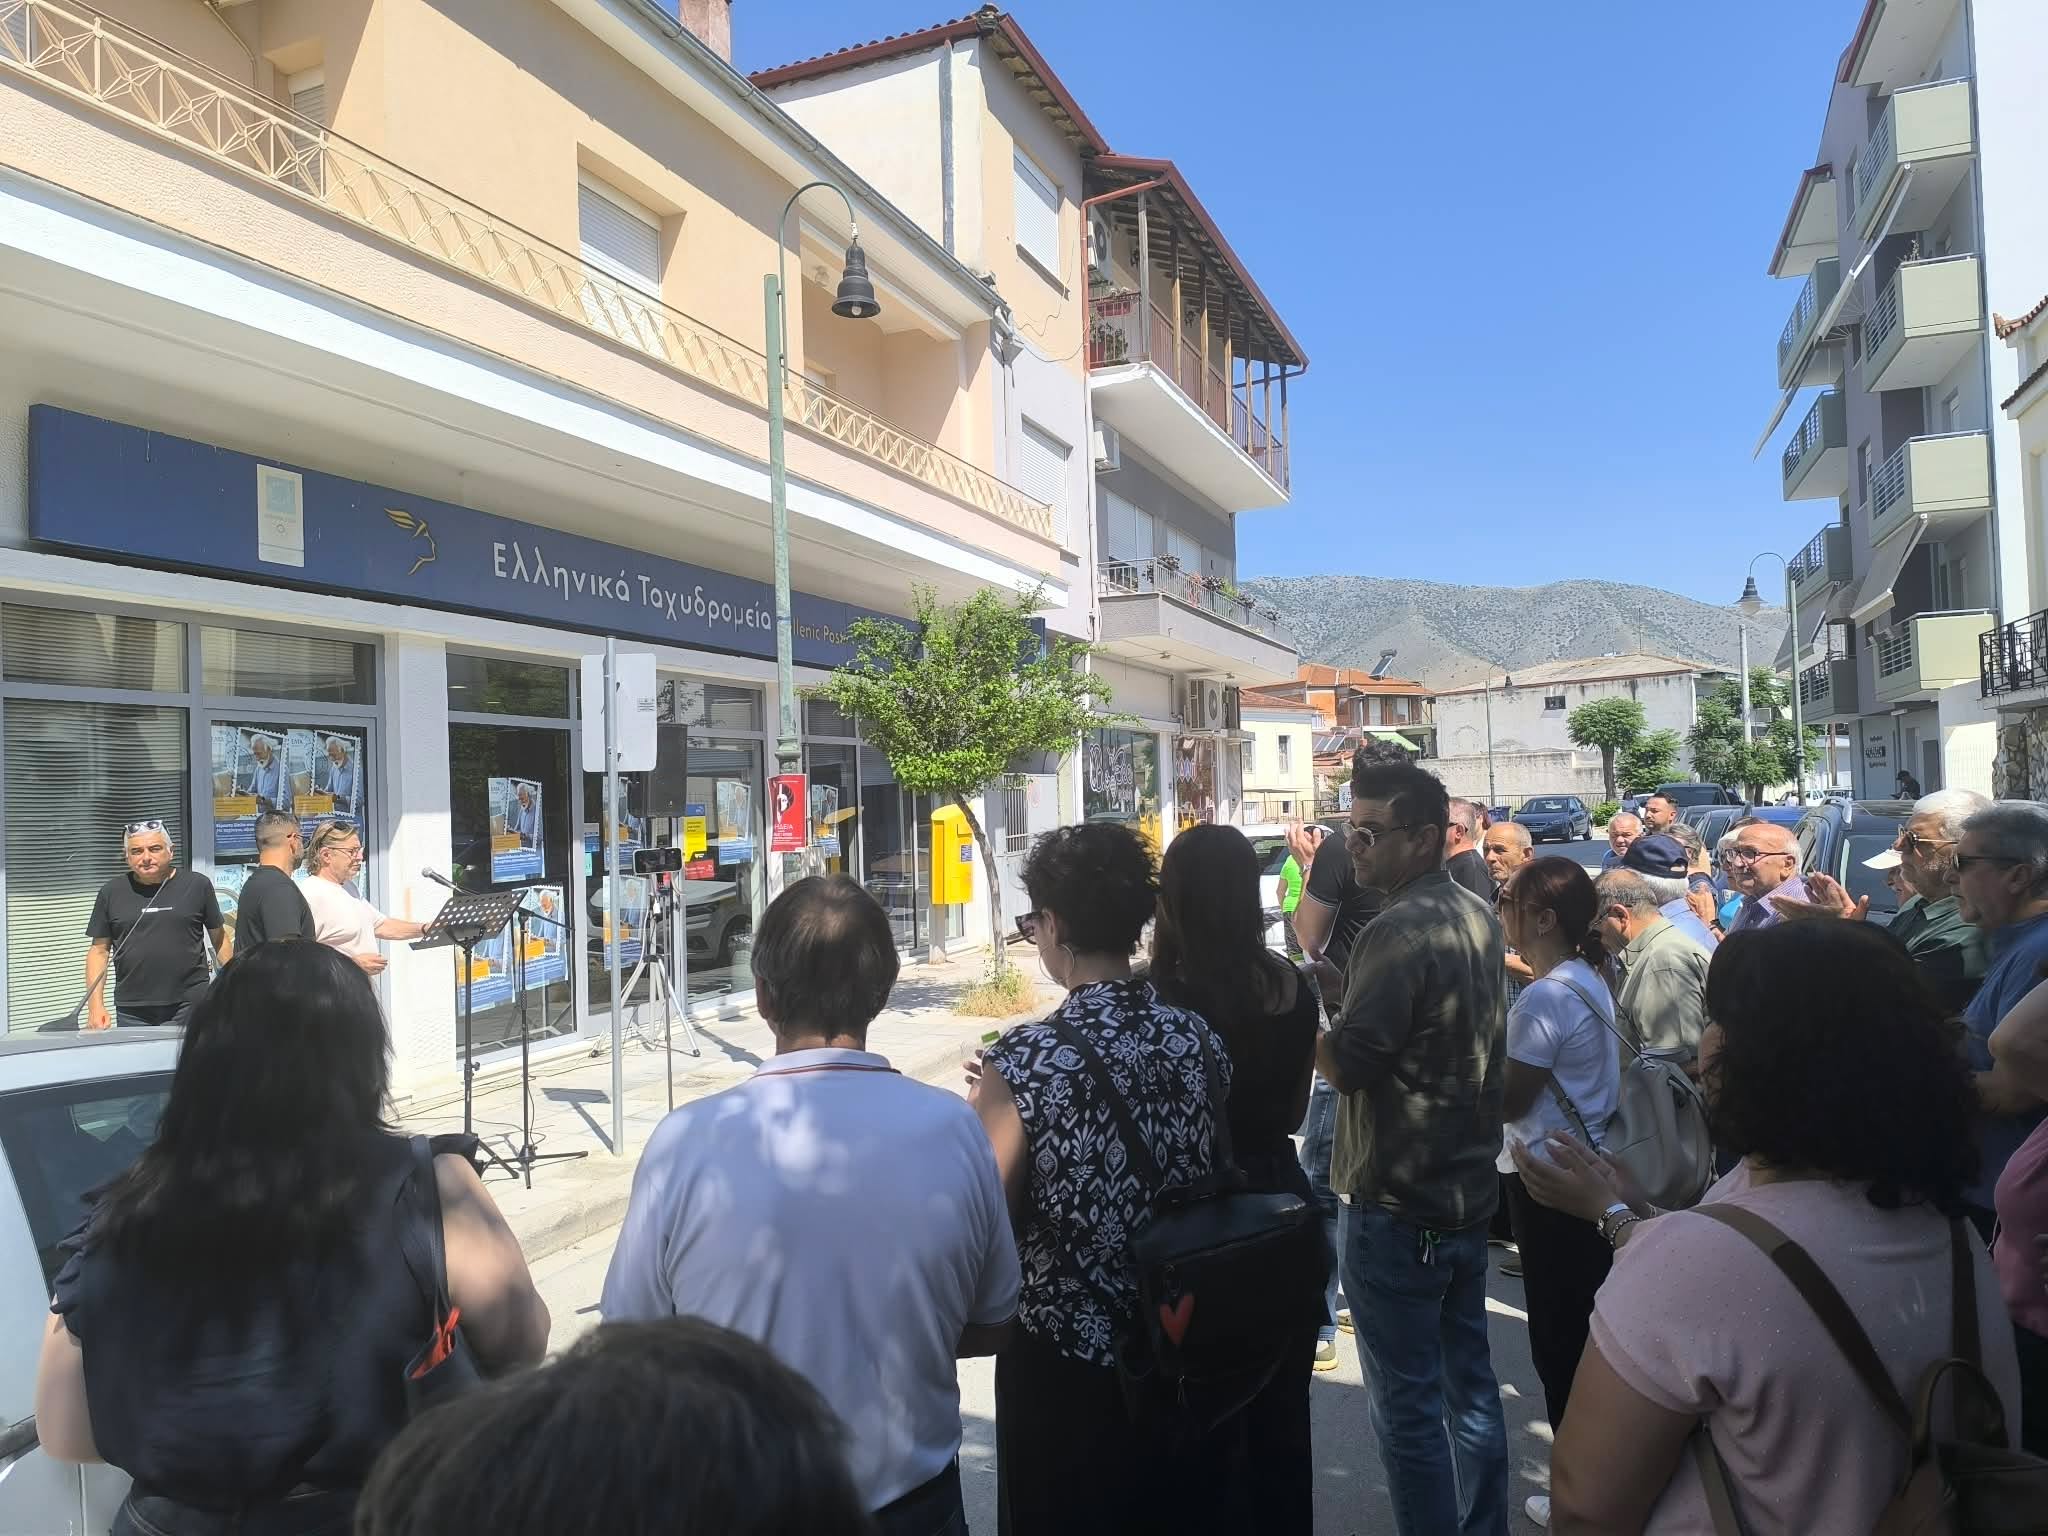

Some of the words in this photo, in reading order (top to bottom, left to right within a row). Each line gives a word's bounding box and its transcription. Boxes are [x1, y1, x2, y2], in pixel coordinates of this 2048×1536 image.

[493, 541, 630, 602] Ελληνικά
[637, 574, 772, 633] Ταχυδρομεία
[793, 616, 821, 641] llenic
